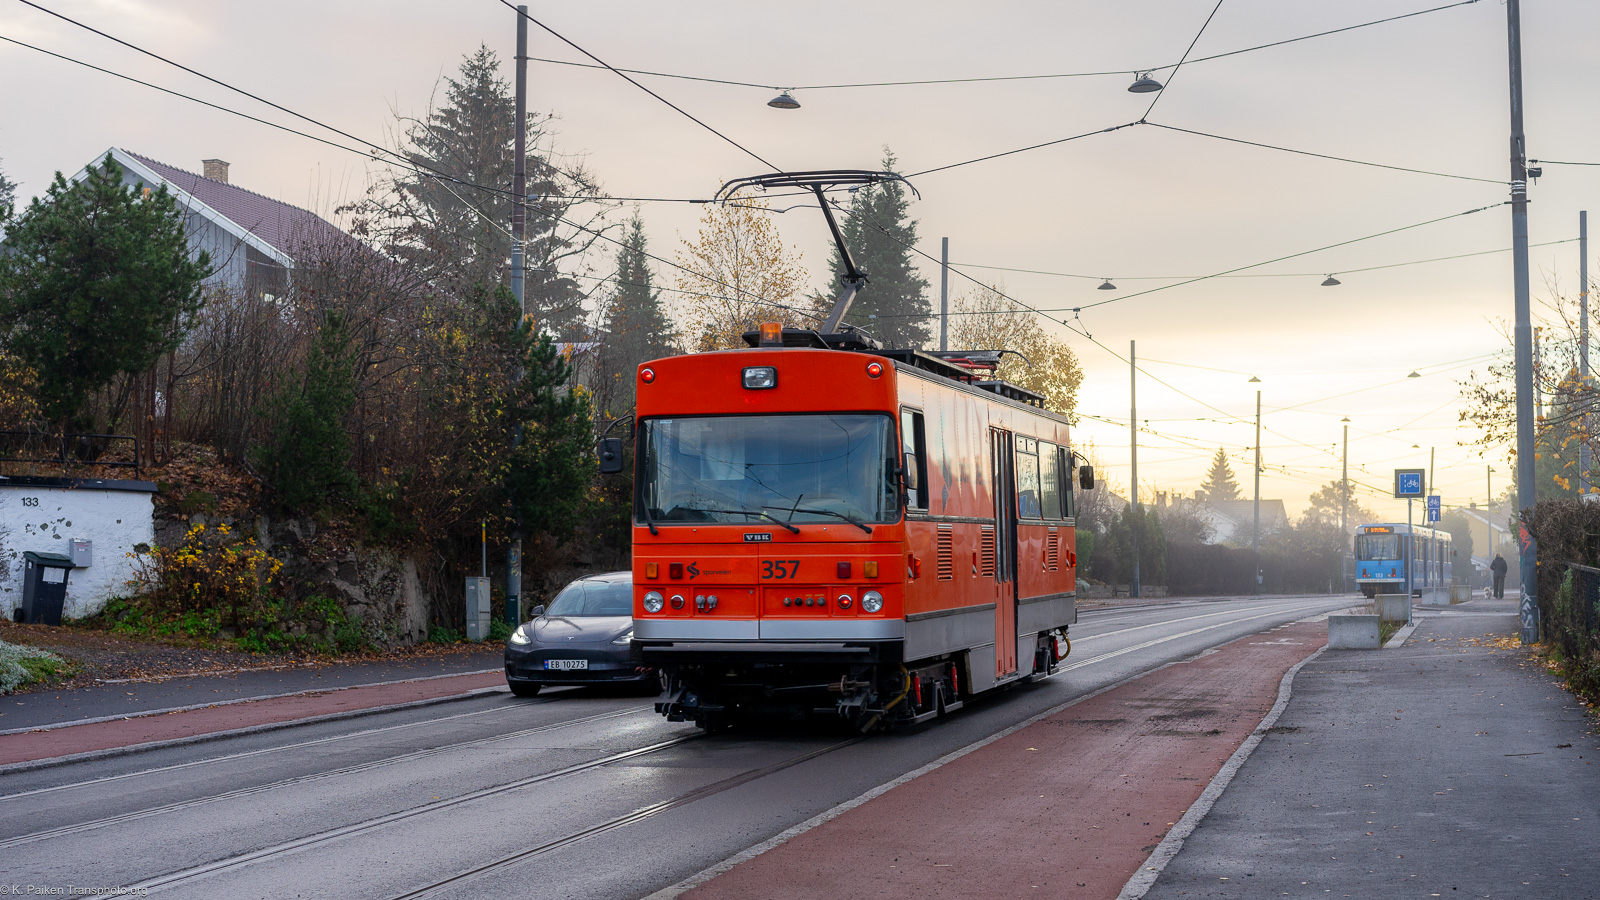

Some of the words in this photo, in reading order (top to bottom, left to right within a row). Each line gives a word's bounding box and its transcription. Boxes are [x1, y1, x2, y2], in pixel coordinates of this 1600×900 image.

[21, 497, 39, 507] 133
[761, 560, 800, 579] 357
[550, 660, 560, 669] EB
[562, 660, 585, 669] 10275
